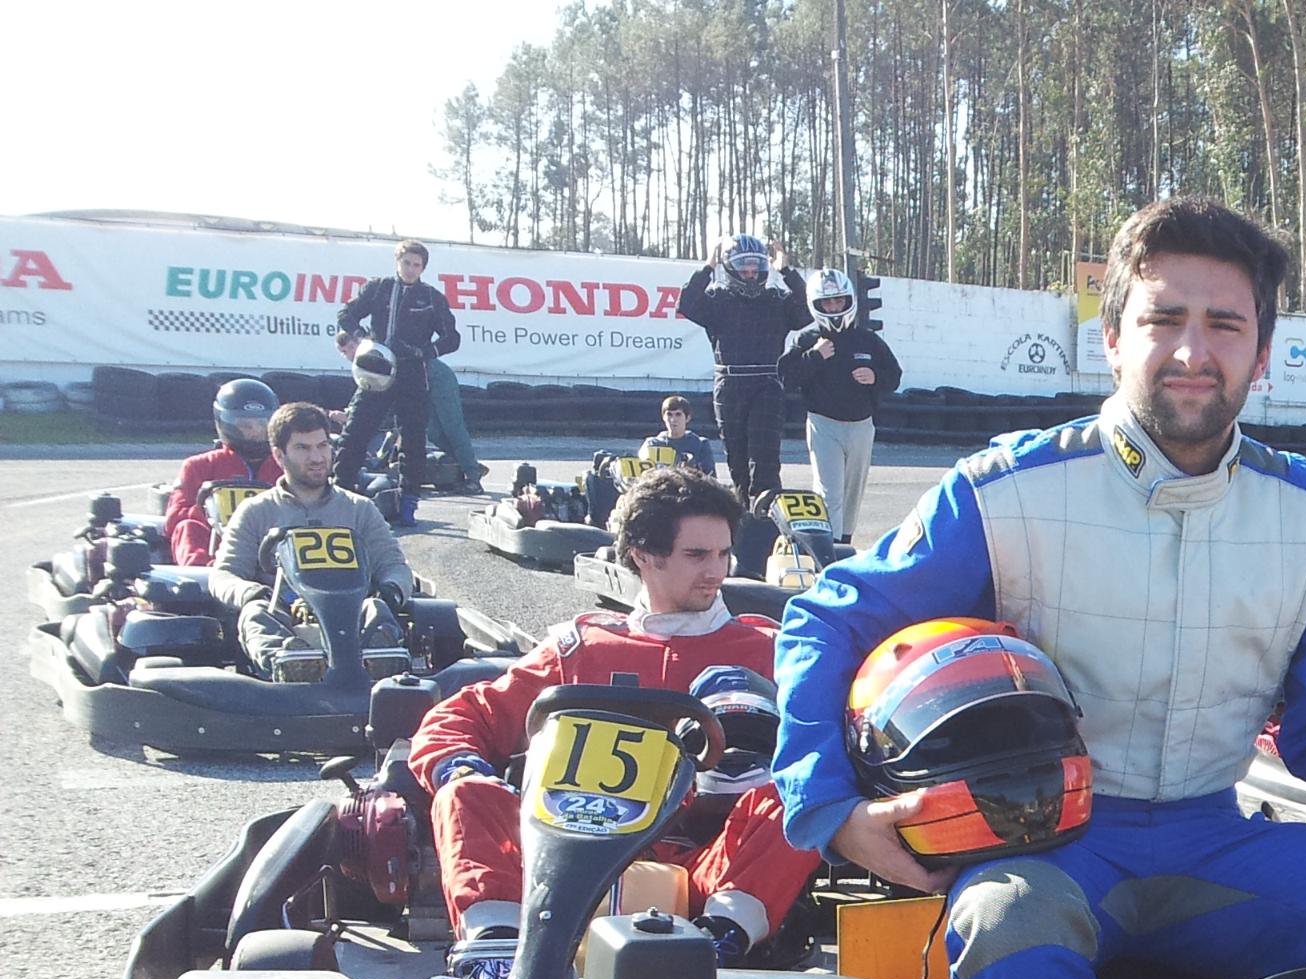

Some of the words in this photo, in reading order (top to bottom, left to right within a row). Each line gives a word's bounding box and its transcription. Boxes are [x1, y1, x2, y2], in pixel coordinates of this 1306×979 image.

[165, 266, 368, 304] EUROIND
[438, 273, 686, 319] HONDA
[266, 315, 320, 336] Utiliza
[467, 324, 506, 344] The
[514, 327, 579, 347] Power
[588, 330, 605, 348] of
[610, 331, 684, 350] Dreams
[783, 495, 822, 517] 25
[294, 531, 355, 565] 26
[553, 722, 646, 793] 15
[565, 796, 606, 813] 24
